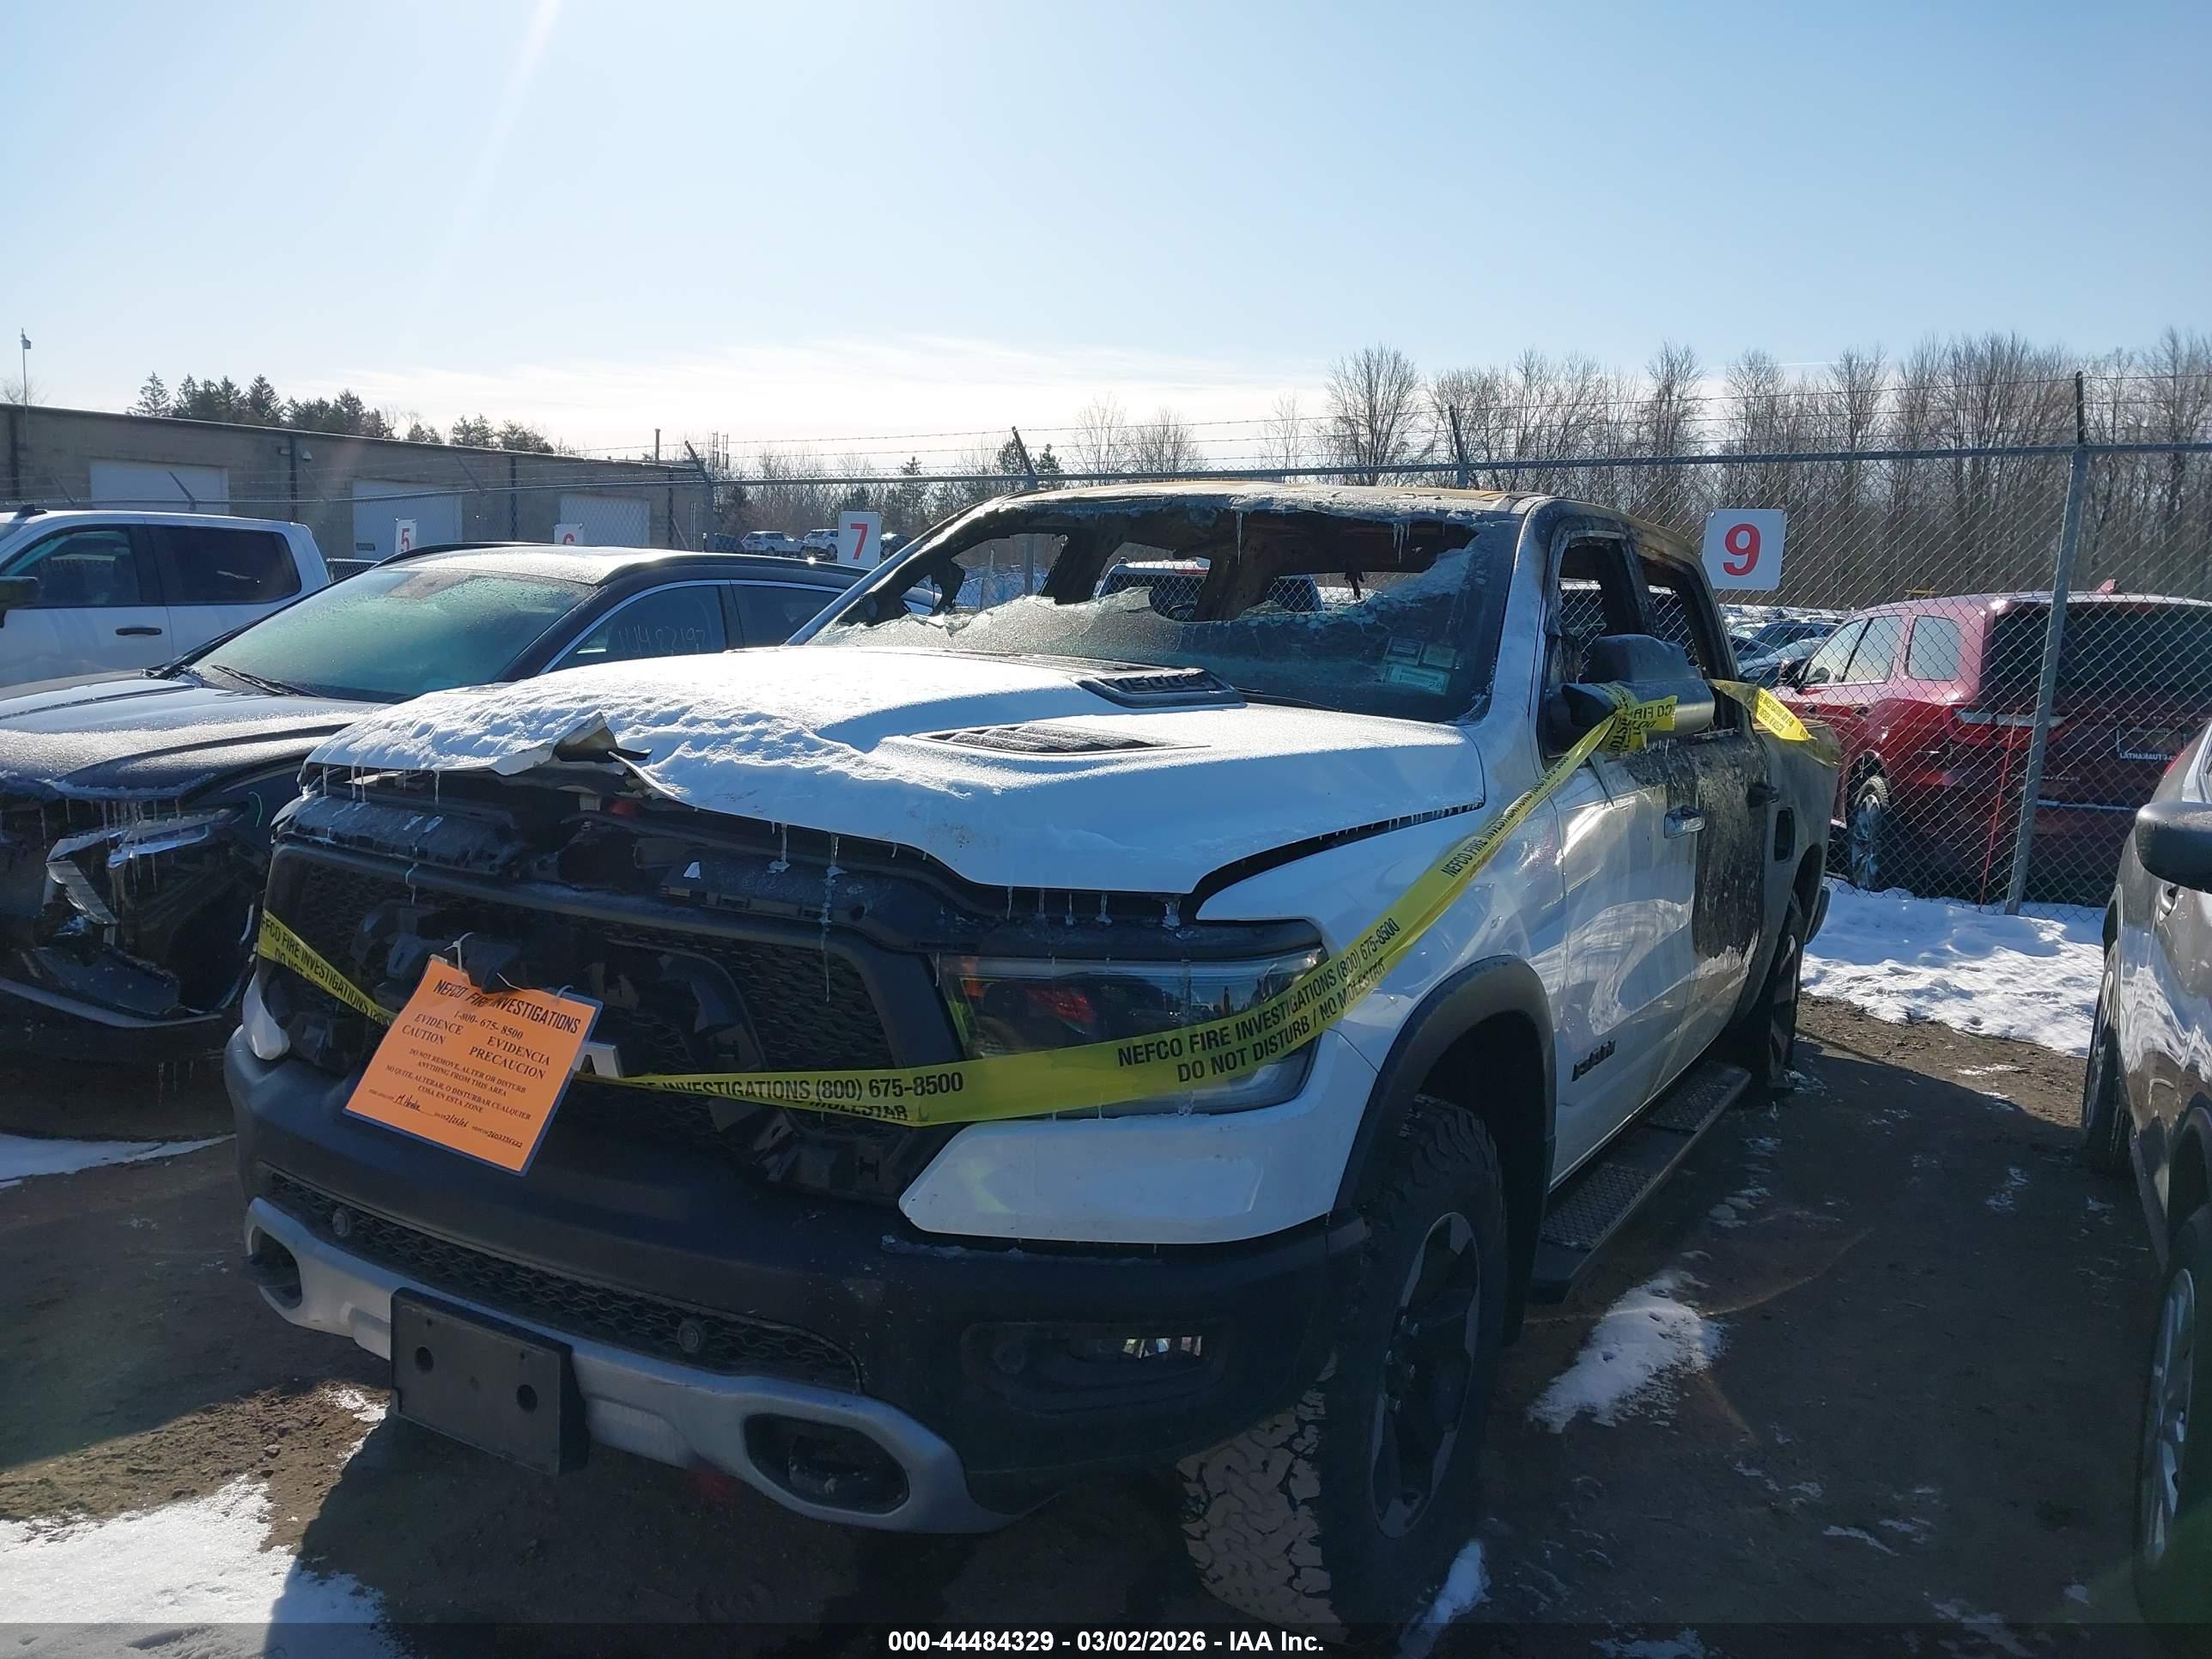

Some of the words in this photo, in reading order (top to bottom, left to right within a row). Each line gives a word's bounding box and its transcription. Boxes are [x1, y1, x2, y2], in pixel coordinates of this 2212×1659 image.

[401, 528, 410, 551] 5
[851, 523, 868, 560] 7
[1723, 523, 1761, 576] 9
[1441, 853, 1474, 878] NEFCO
[1463, 838, 1488, 855] FIRE
[282, 932, 300, 959] FIRE
[301, 950, 368, 1015] INVESTIGATIONS
[1118, 1037, 1183, 1066] NEFCO
[1188, 1026, 1231, 1053] FIRE
[1235, 970, 1337, 1042] INVESTIGATIONS
[1337, 950, 1362, 982] (800)
[1359, 917, 1401, 961] 675-8500
[402, 1024, 447, 1045] CAUTION
[414, 1013, 465, 1036] EVIDENCE
[501, 1024, 524, 1040] 8500
[1177, 1060, 1206, 1083] DO
[1210, 1048, 1248, 1075] NOT
[1252, 1014, 1310, 1061] DISTURB
[1312, 1008, 1317, 1028] /
[1319, 996, 1339, 1021] NO
[468, 1046, 547, 1080] PRECAUCION
[487, 1036, 551, 1066] EVIDENCIA
[1572, 1040, 1616, 1082] RAM
[417, 1061, 450, 1077] ANYTHING
[451, 1072, 471, 1086] FROM
[471, 1078, 488, 1090] THIS
[488, 1084, 507, 1097] AREA
[461, 1065, 483, 1080] ALTER
[484, 1073, 496, 1082] OR
[495, 1076, 526, 1094] DISTURB
[816, 1079, 862, 1101] (800)
[868, 1072, 963, 1098] 675-8500
[445, 1094, 465, 1108] ESTA
[465, 1101, 484, 1114] ZONE
[452, 1086, 491, 1105] DISTURBAR
[491, 1097, 532, 1121] CUALQUIER
